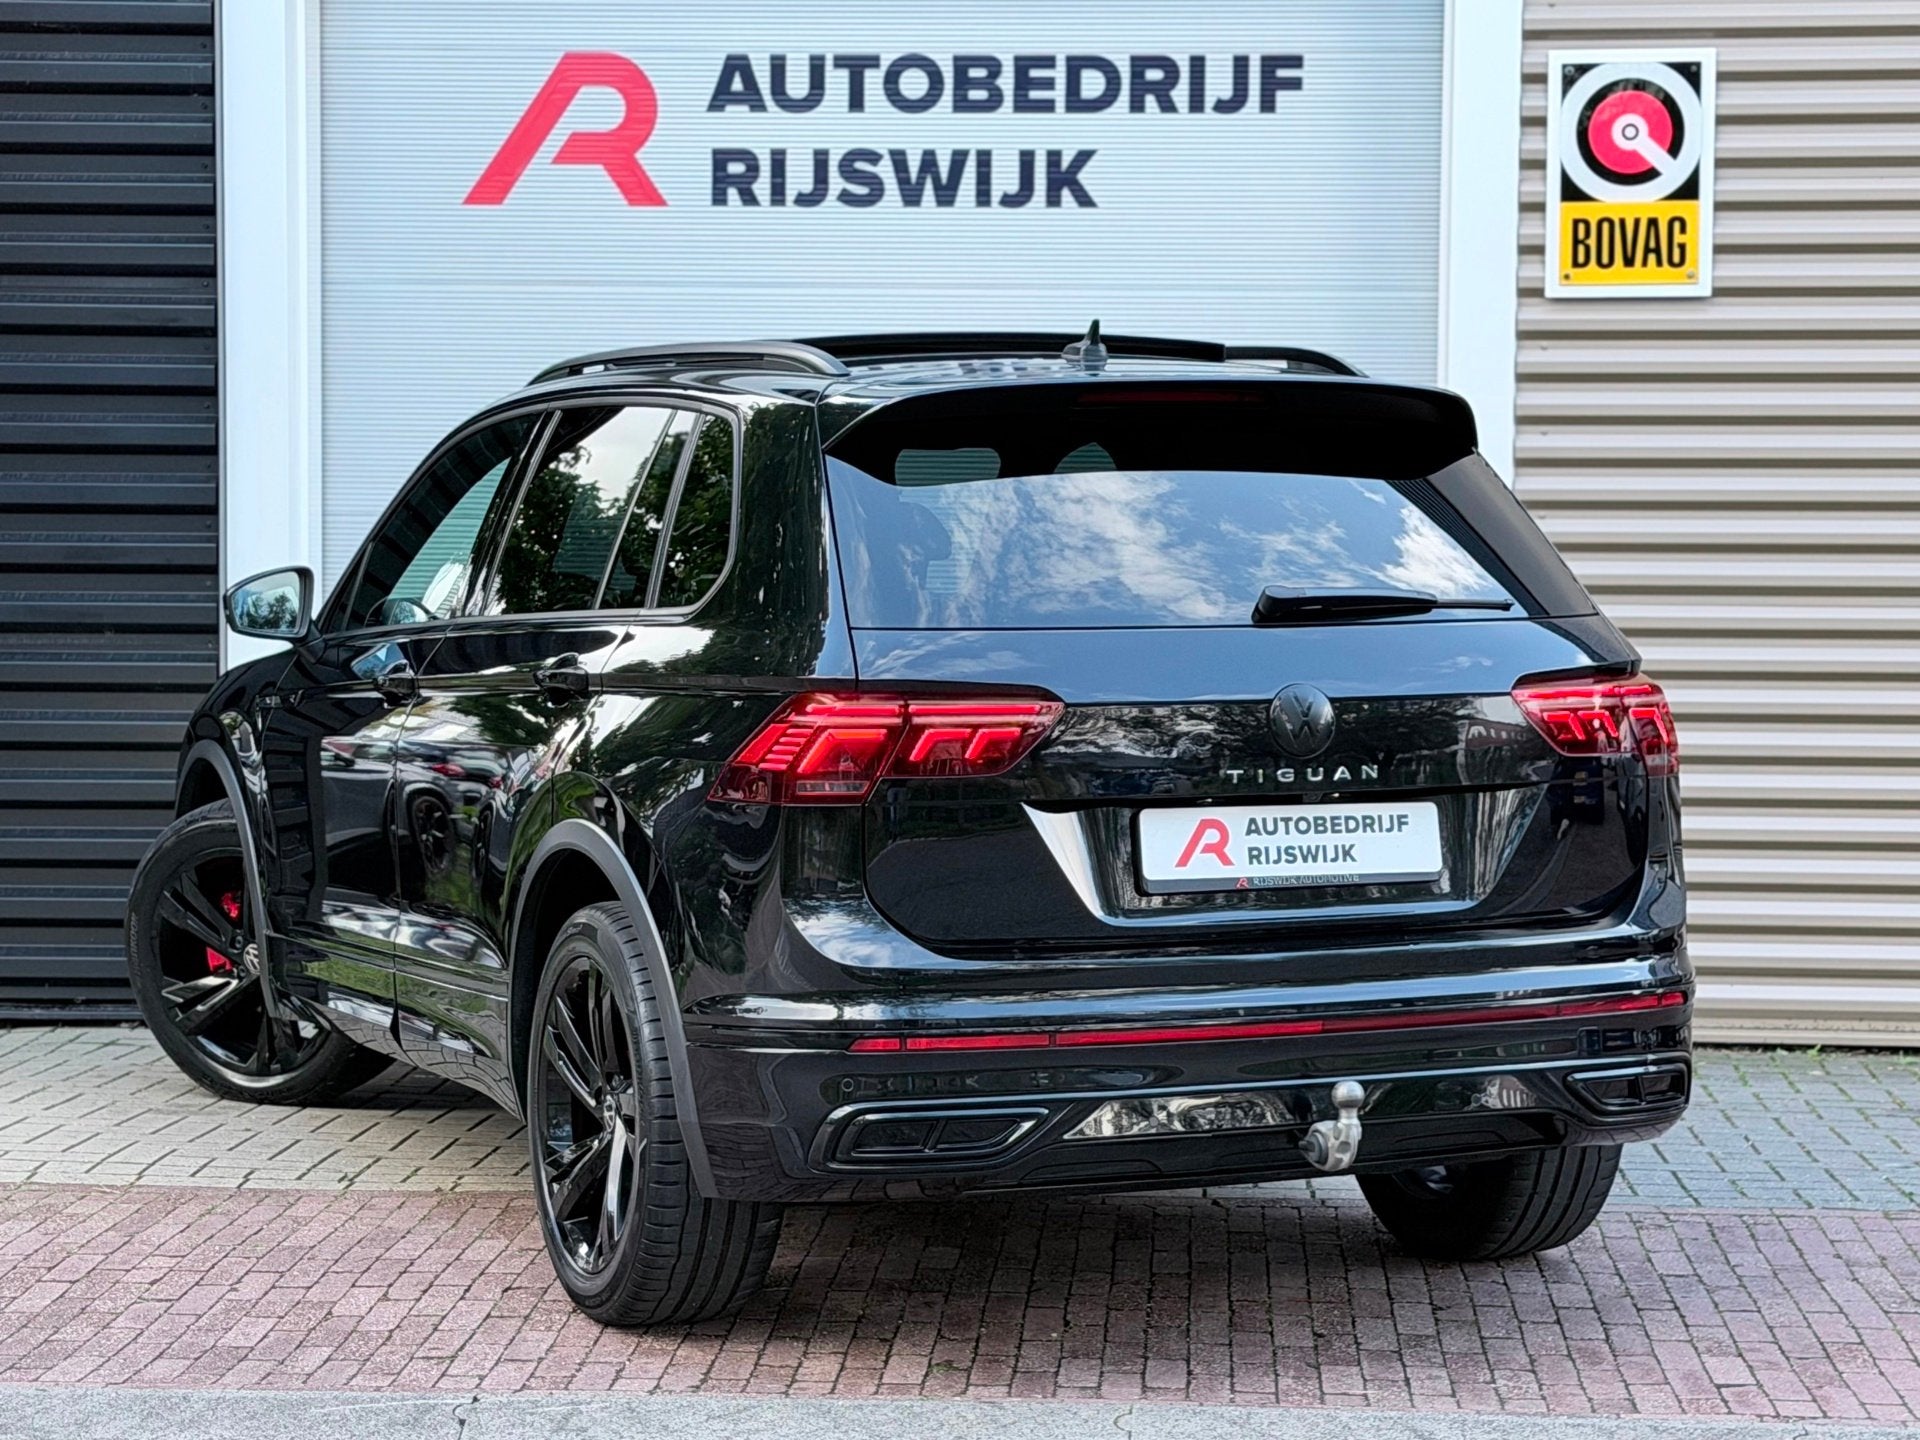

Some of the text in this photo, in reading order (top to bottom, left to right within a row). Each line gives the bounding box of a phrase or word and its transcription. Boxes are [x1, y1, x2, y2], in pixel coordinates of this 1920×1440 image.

[707, 53, 1304, 115] AUTOBEDRIJF
[711, 147, 1098, 208] RIJSWIJK
[1571, 216, 1688, 269] BOVAG
[1226, 764, 1379, 785] TIGUAN
[1244, 814, 1410, 836] AUTOBEDRIJF
[1247, 844, 1357, 865] RIJSWIJK
